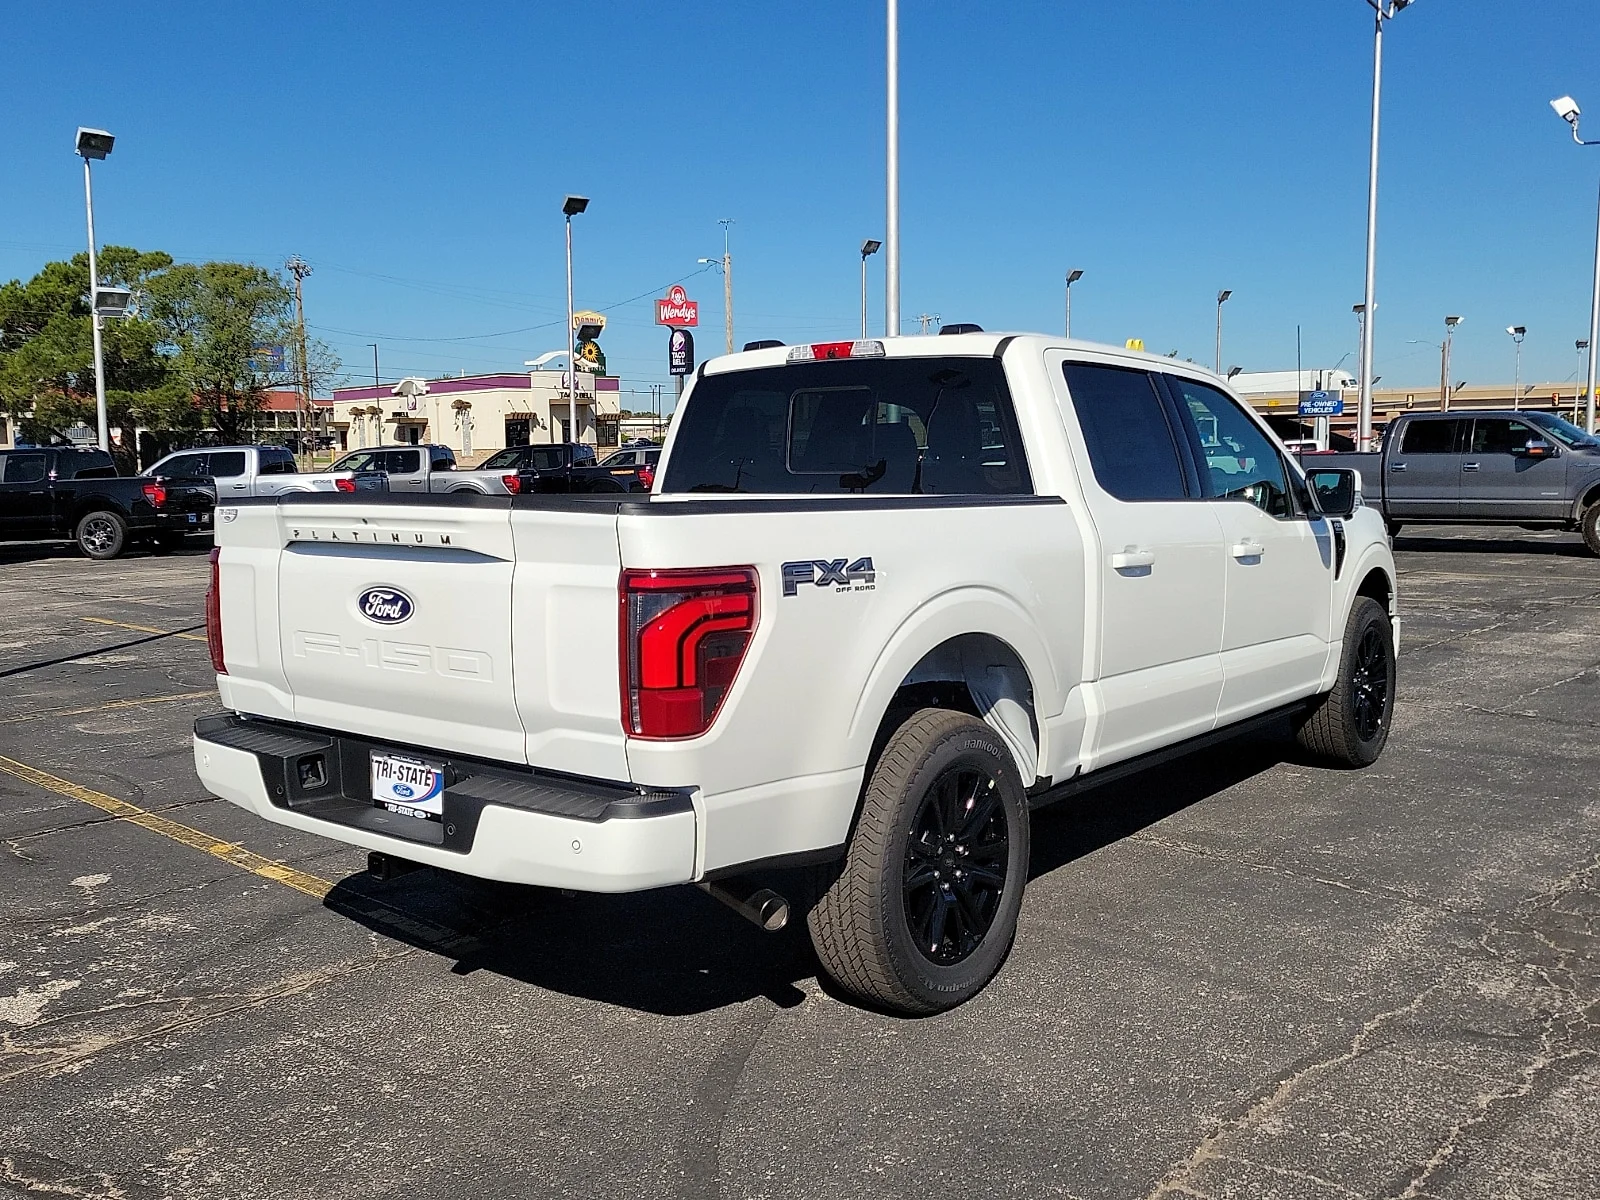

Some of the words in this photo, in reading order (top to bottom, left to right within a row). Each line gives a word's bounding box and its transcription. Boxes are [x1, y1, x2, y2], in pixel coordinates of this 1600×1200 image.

[660, 304, 696, 322] Wendy's
[671, 351, 686, 359] TACO
[560, 391, 578, 399] TAO
[293, 529, 452, 545] PLATINUM
[781, 556, 876, 597] FX4
[855, 584, 876, 592] ROAD
[365, 591, 403, 619] Ford
[293, 630, 494, 683] F-150
[374, 759, 431, 787] TRI-STATE
[387, 804, 414, 816] TRI-STATE
